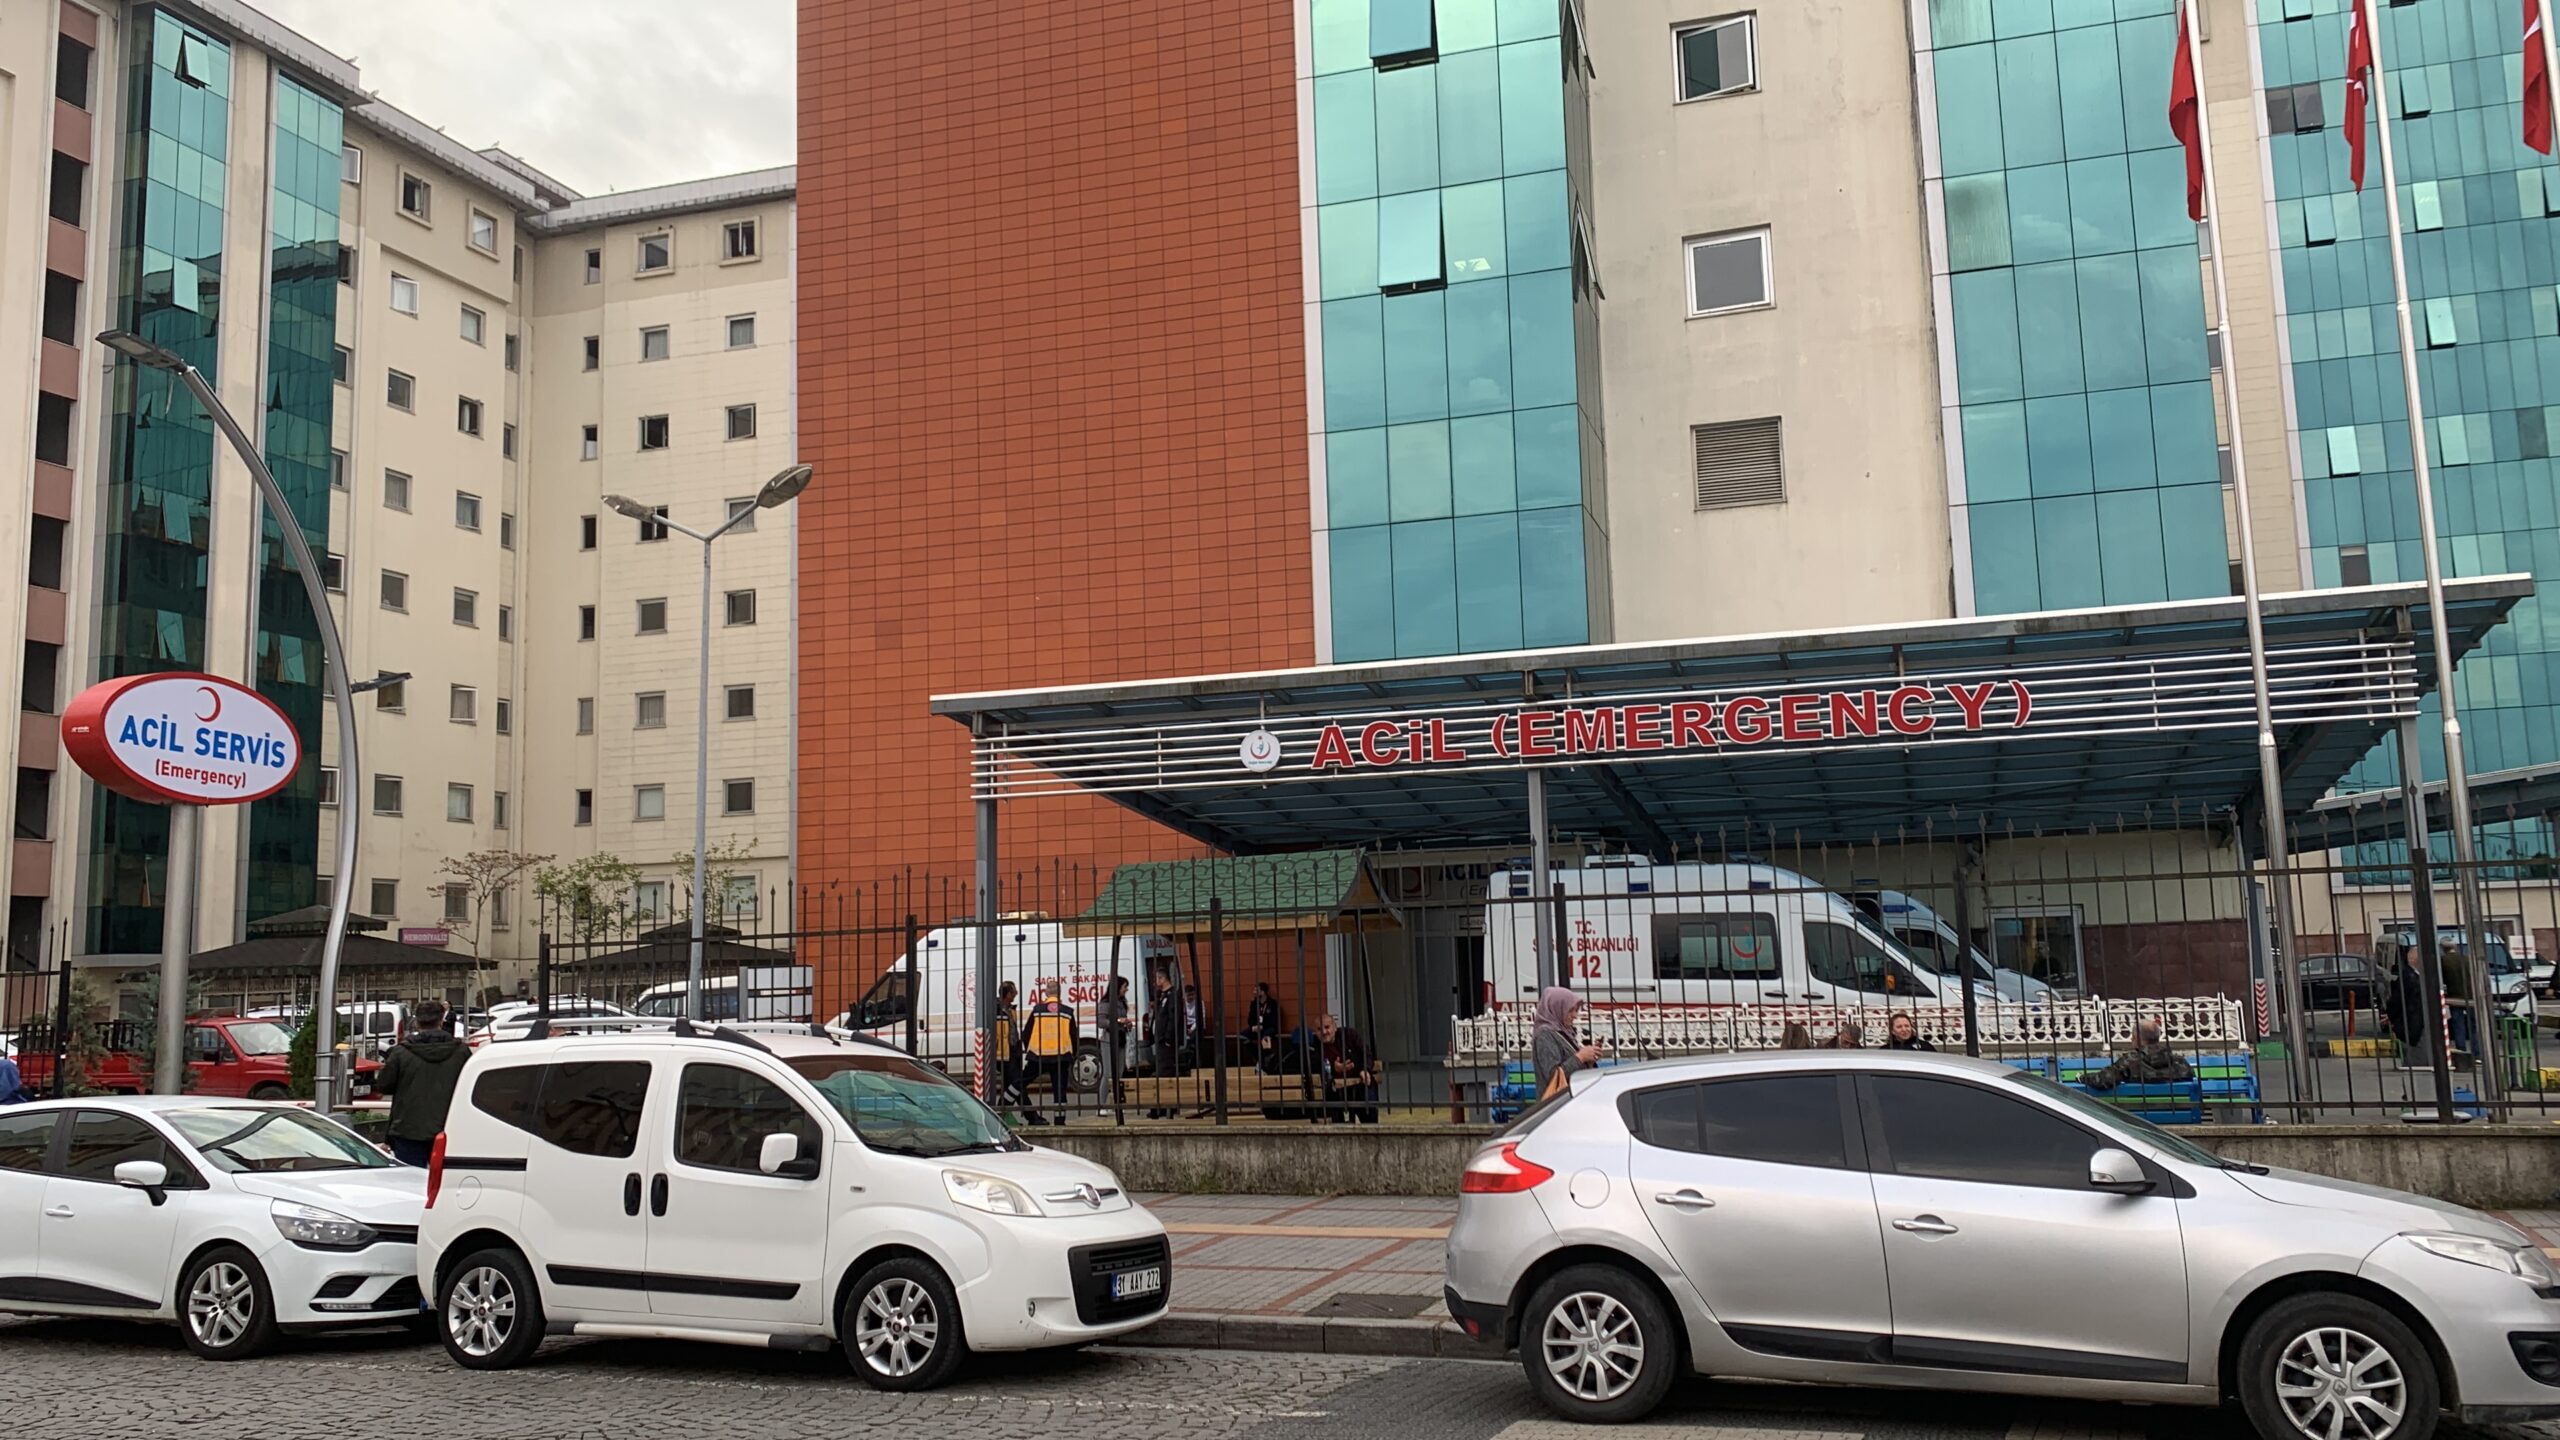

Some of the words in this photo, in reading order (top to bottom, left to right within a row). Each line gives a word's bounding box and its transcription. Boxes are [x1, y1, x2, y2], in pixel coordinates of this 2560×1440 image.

[119, 713, 185, 753] ACİL
[194, 727, 286, 769] SERVİS
[1491, 679, 2033, 759] (EMERGENCY)
[155, 758, 246, 790] (Emergency)
